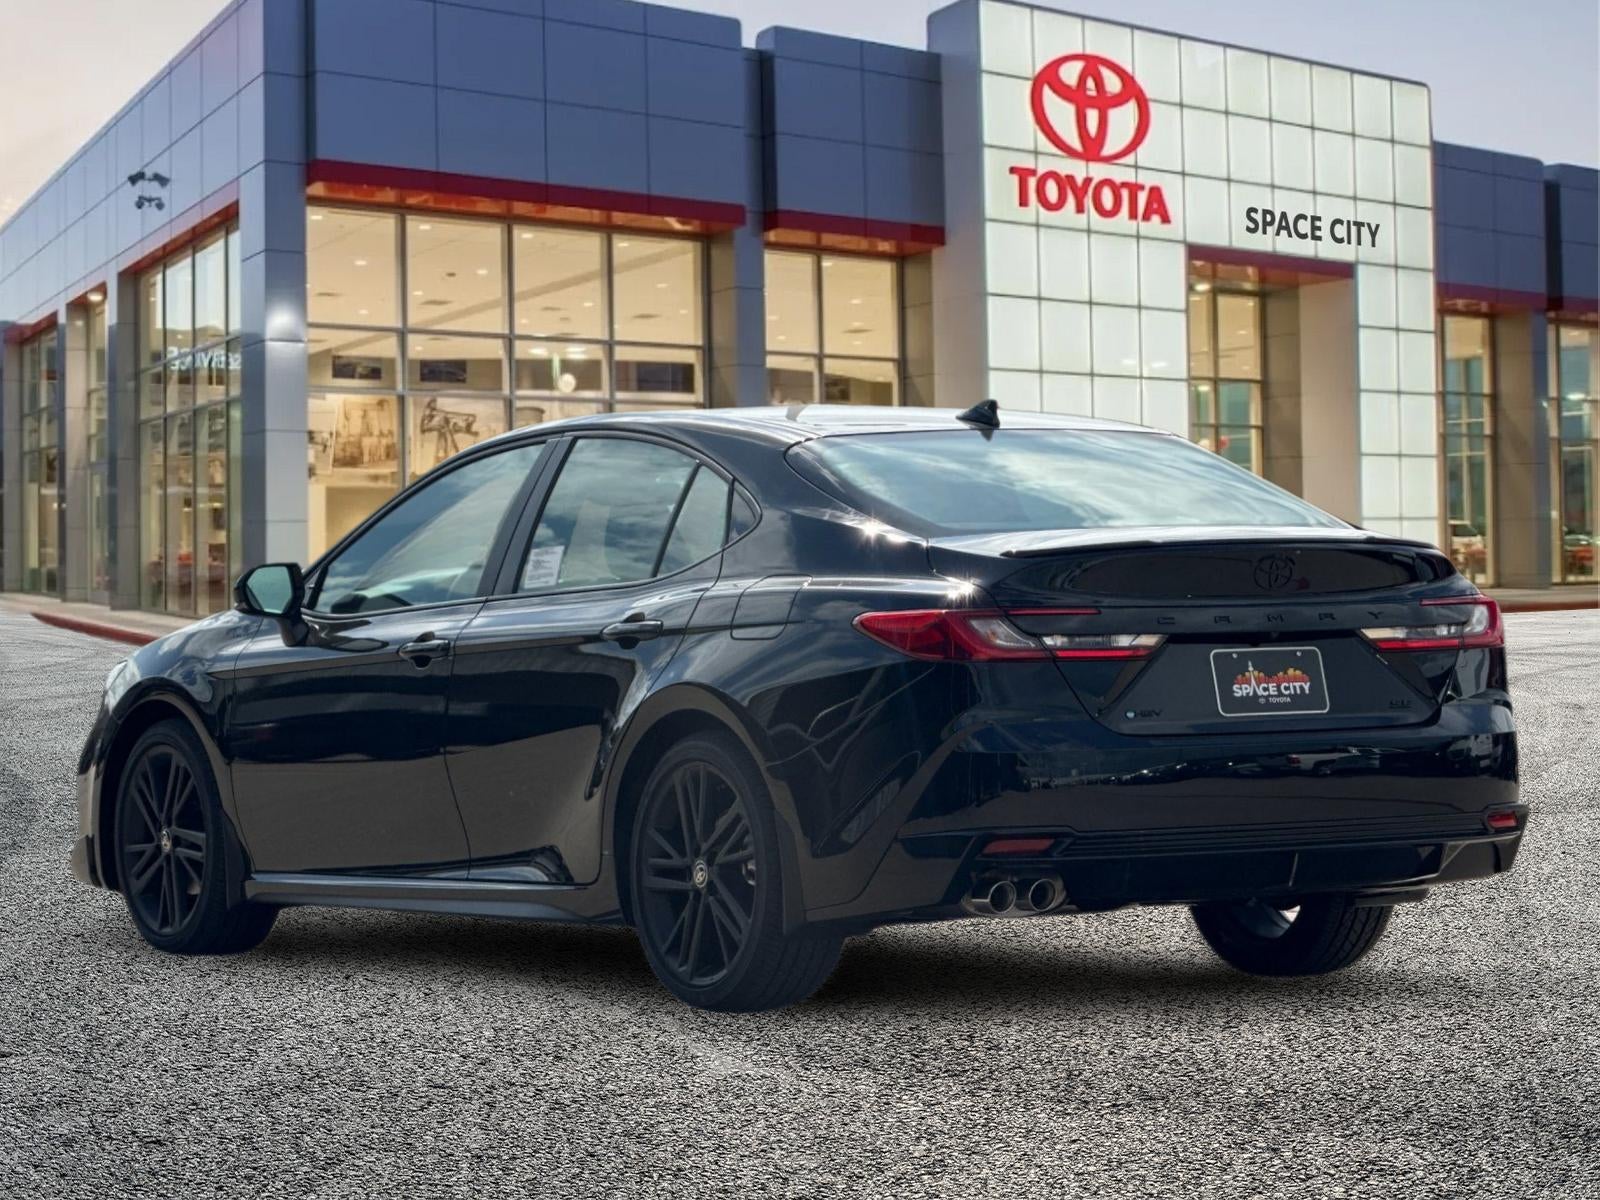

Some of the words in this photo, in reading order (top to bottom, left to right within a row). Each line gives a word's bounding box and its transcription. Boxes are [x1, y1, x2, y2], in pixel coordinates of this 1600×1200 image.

[1009, 166, 1171, 225] TOYOTA
[1245, 206, 1323, 242] SPACE
[1329, 218, 1381, 248] CITY
[1157, 610, 1385, 625] CAMRY
[1232, 676, 1278, 698] SPACE
[1280, 681, 1311, 696] CITY
[1268, 696, 1292, 704] TOYOTA
